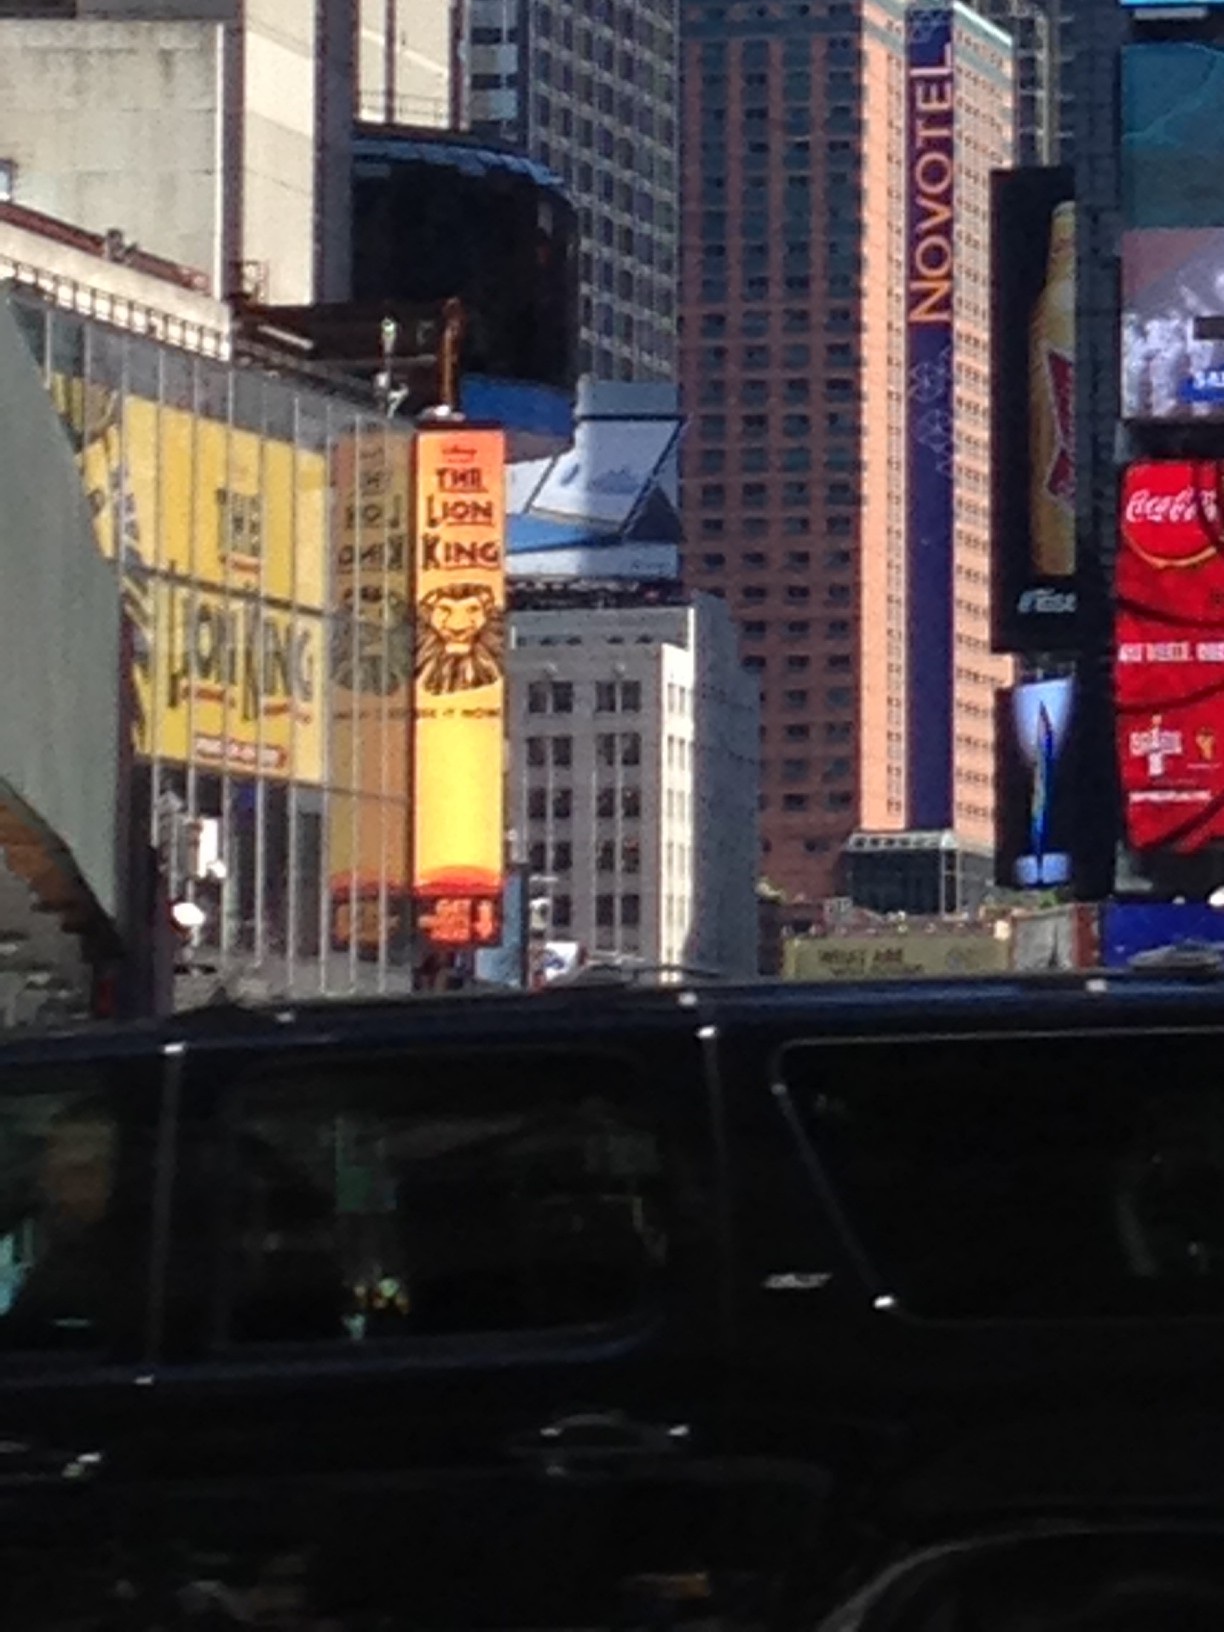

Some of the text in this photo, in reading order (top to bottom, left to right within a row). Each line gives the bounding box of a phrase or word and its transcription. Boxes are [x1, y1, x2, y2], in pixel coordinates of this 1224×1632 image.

[909, 43, 953, 324] NOVOTEL
[436, 468, 486, 493] THE
[426, 495, 494, 528] LION
[421, 533, 500, 570] KING
